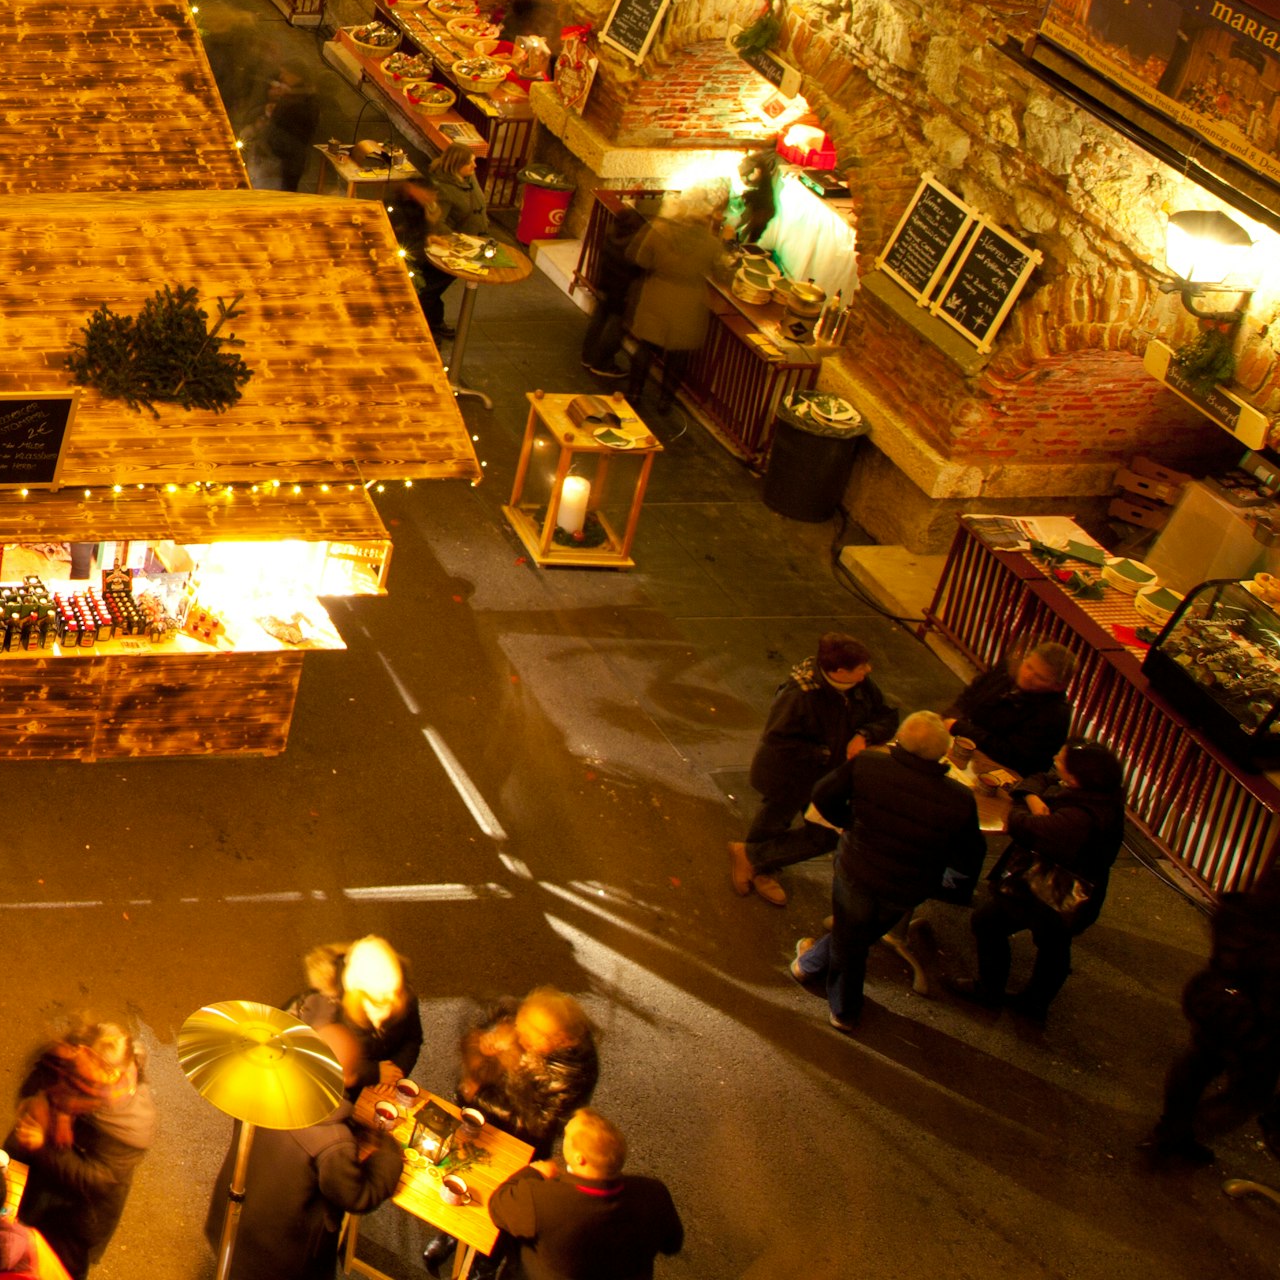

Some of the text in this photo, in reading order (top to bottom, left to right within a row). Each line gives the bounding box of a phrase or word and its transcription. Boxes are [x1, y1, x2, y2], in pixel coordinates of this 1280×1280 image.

[1042, 23, 1053, 35] An
[1054, 30, 1070, 46] allen
[1070, 39, 1085, 54] vier
[1154, 87, 1181, 118] Freitag
[1194, 120, 1229, 149] Sonntag
[1229, 137, 1248, 156] und
[1248, 150, 1257, 163] 8.
